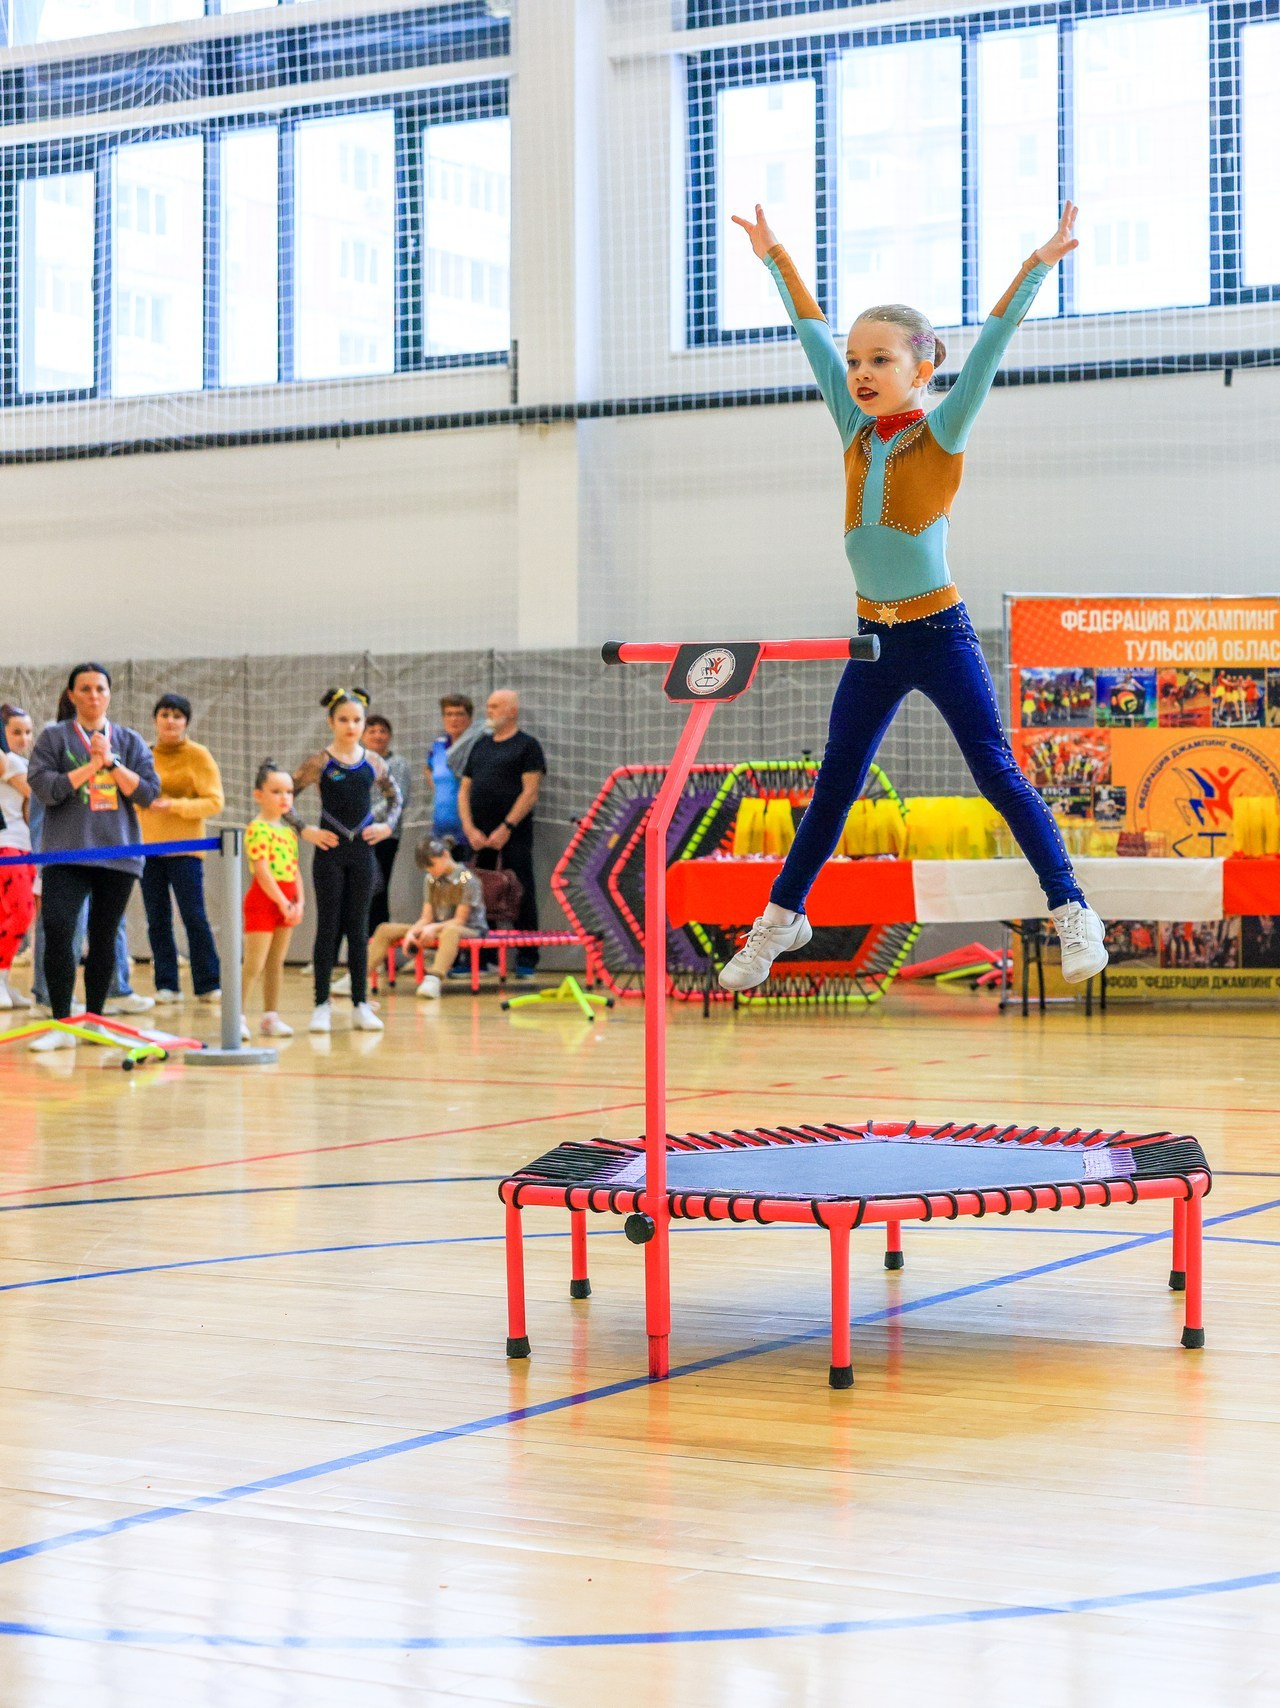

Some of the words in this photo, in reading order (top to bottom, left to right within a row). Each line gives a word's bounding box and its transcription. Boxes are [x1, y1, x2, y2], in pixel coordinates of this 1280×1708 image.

[1060, 608, 1171, 635] ФЕДЕРАЦИЯ
[1173, 608, 1279, 634] ДЖАМПИНГ
[1124, 637, 1219, 662] ТУЛЬСКОЙ
[1170, 739, 1228, 759] ДЖАМПИНГ
[1211, 974, 1273, 989] ДЖАМПИНГ
